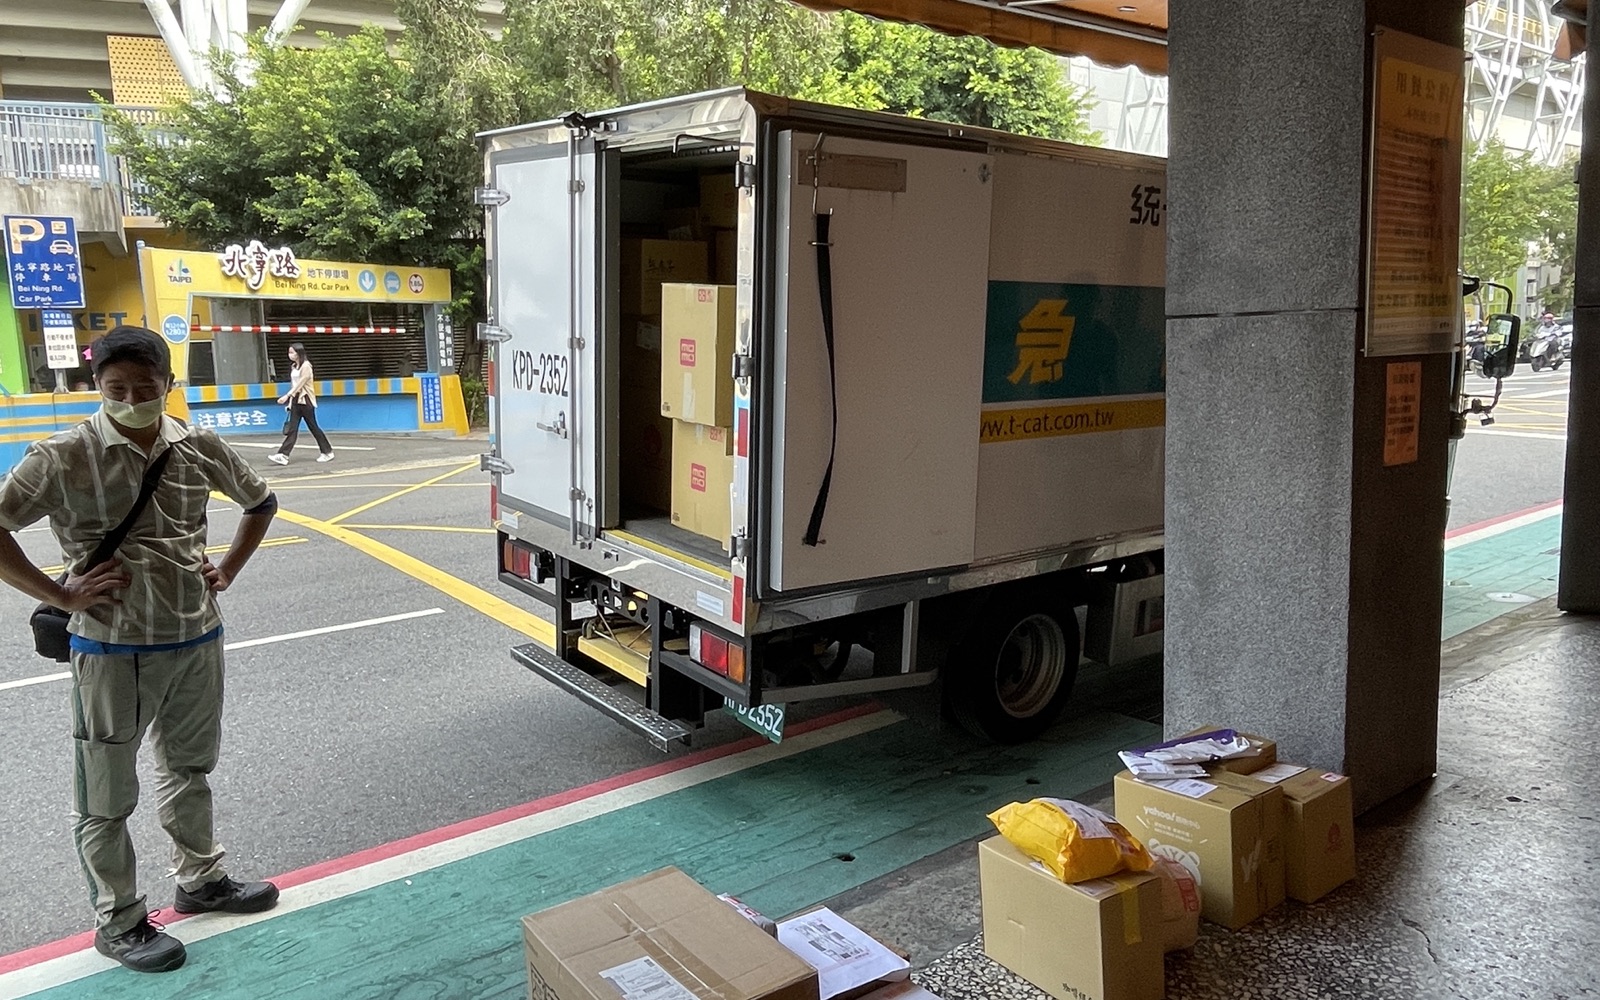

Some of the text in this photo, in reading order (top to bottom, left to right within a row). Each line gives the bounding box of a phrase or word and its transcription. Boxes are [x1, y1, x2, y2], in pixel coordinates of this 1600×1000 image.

[1130, 184, 1167, 226] 統
[9, 218, 45, 254] P
[14, 263, 76, 272] 北寧路地下
[15, 273, 77, 283] 停車場
[168, 275, 192, 283] TAIPEI
[307, 268, 349, 280] 地下停車場
[32, 285, 50, 293] Ning
[275, 281, 287, 289] Bei
[289, 282, 306, 292] Ning
[321, 283, 333, 291] Car
[335, 284, 350, 292] Park
[19, 295, 53, 303] Car Park
[512, 349, 568, 397] KPD-2352
[197, 409, 268, 429] 注意安全
[1143, 805, 1176, 822] yahoo!
